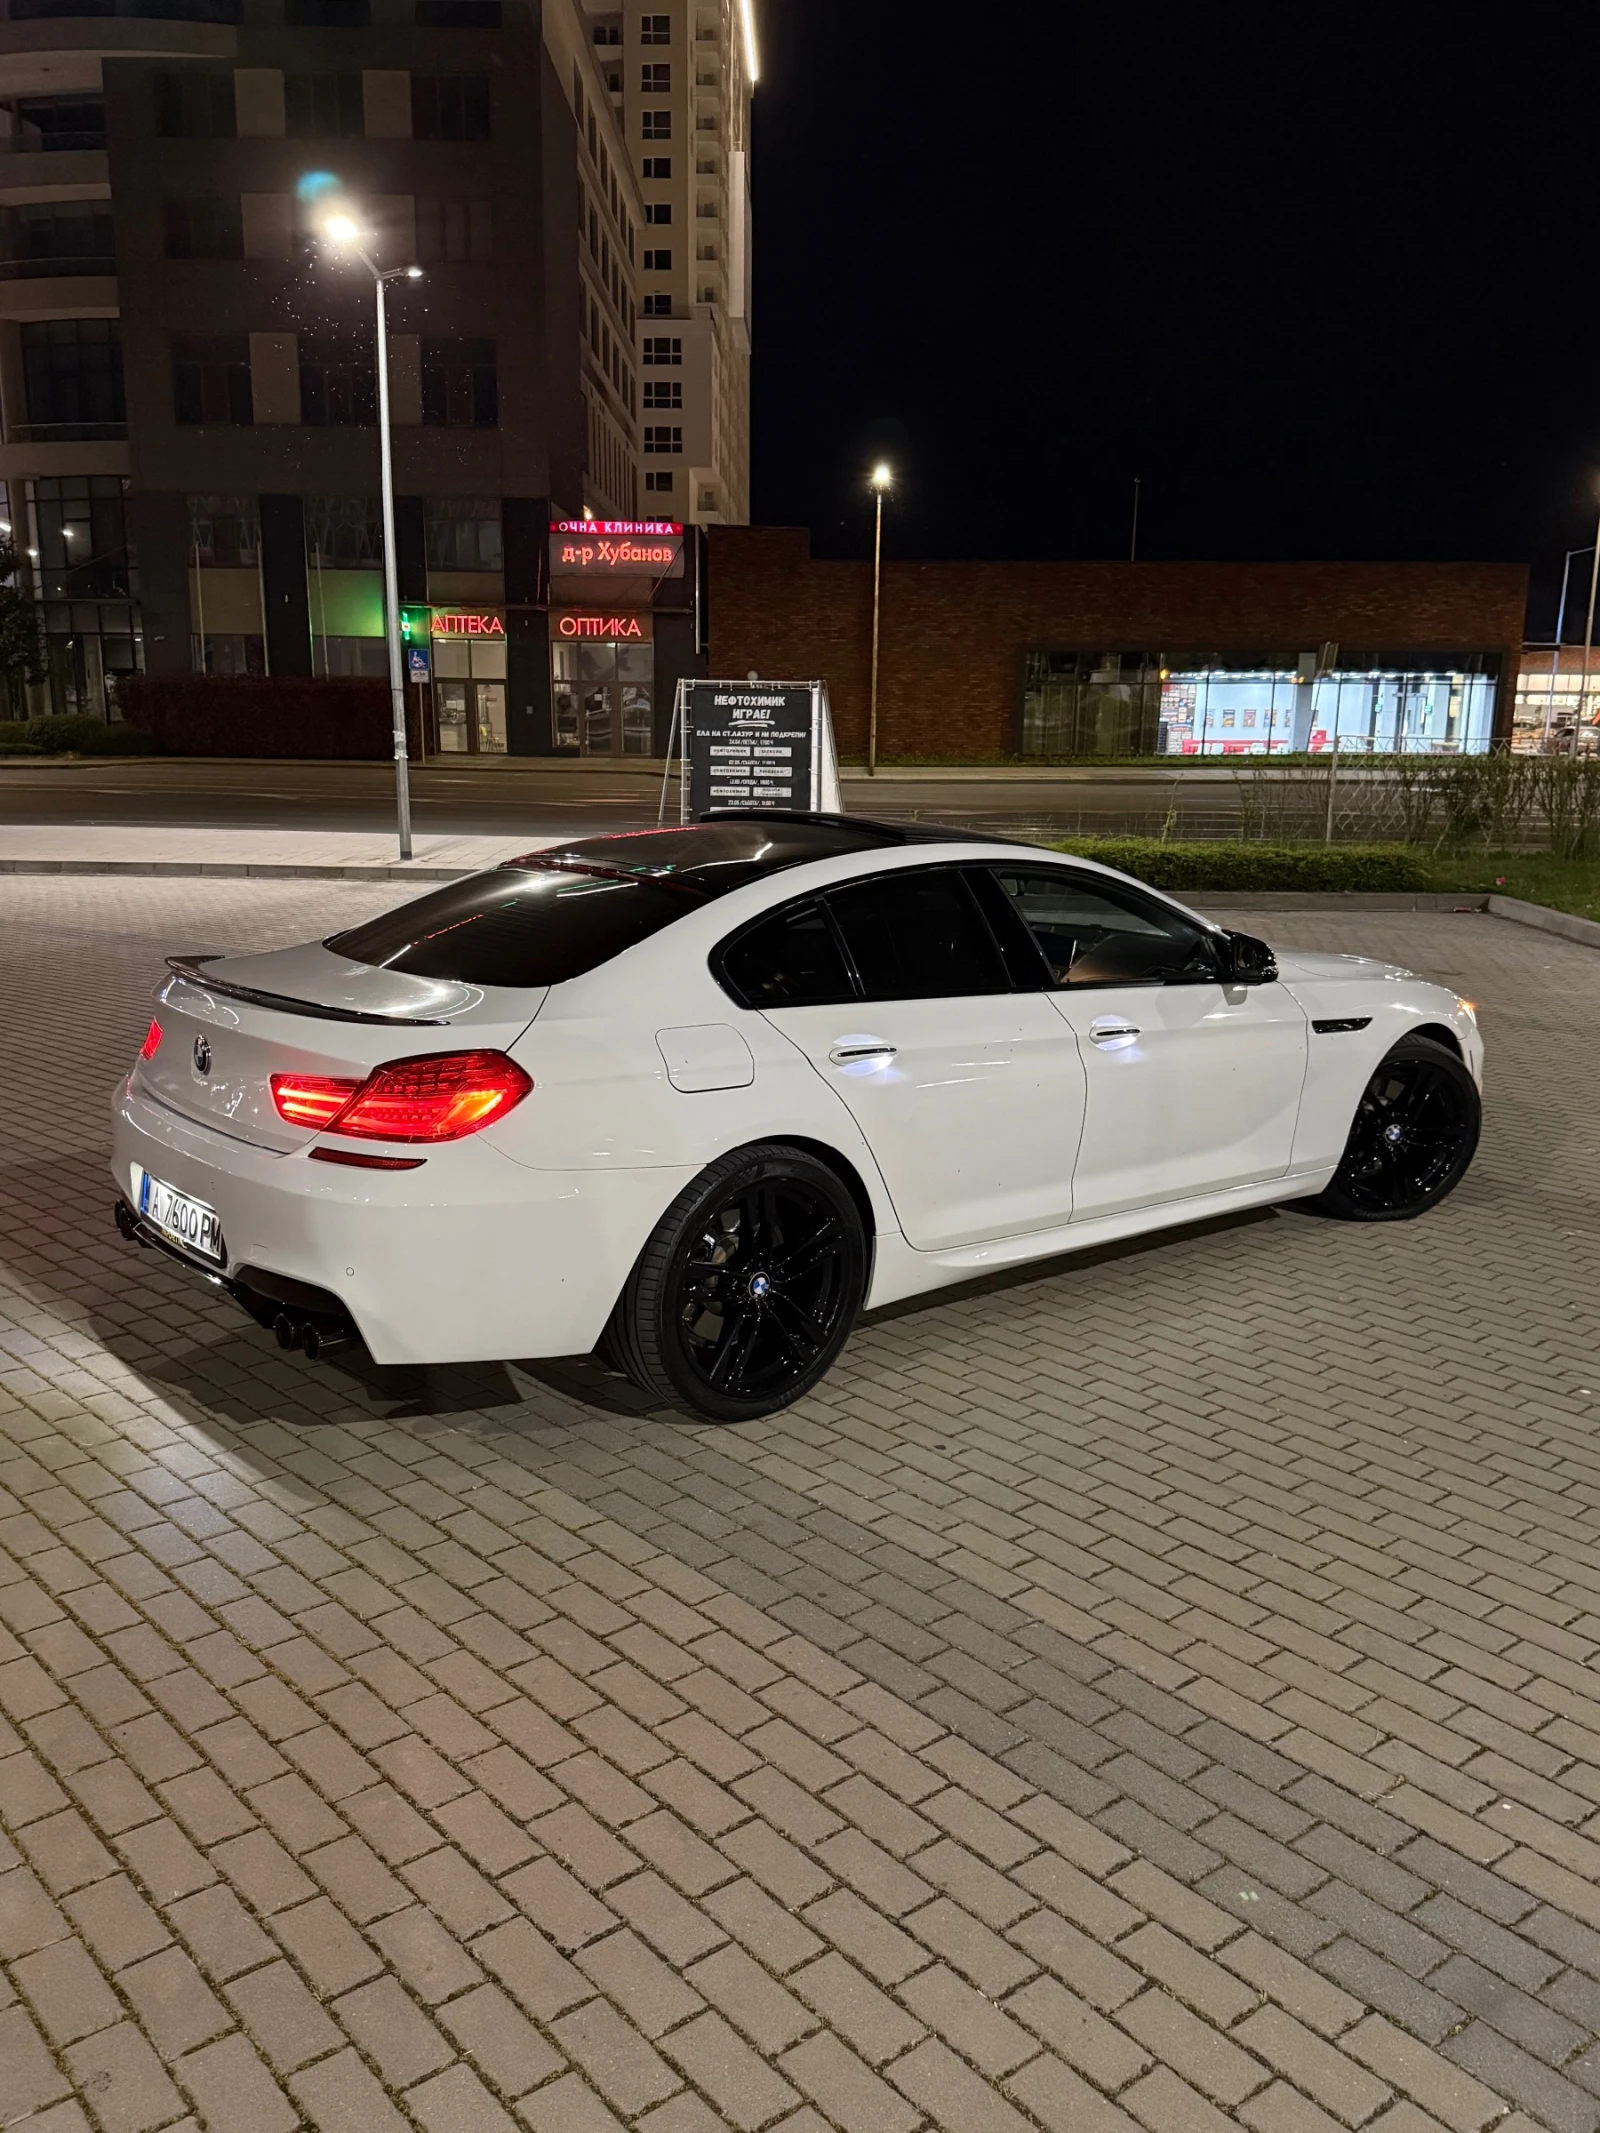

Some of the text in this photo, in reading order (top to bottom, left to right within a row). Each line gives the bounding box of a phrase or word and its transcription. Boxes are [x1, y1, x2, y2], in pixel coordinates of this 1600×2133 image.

[559, 522, 674, 534] ОЧНА КЛИНИКА
[561, 541, 673, 566] д-р Хубанов
[430, 614, 504, 635] АПТЕКА
[559, 617, 642, 637] ОПТИКА
[714, 694, 786, 707] НЕФТОХИМИК
[732, 708, 771, 720] ИГРАЕ!
[165, 1193, 198, 1240] 7600
[200, 1212, 221, 1253] PM
